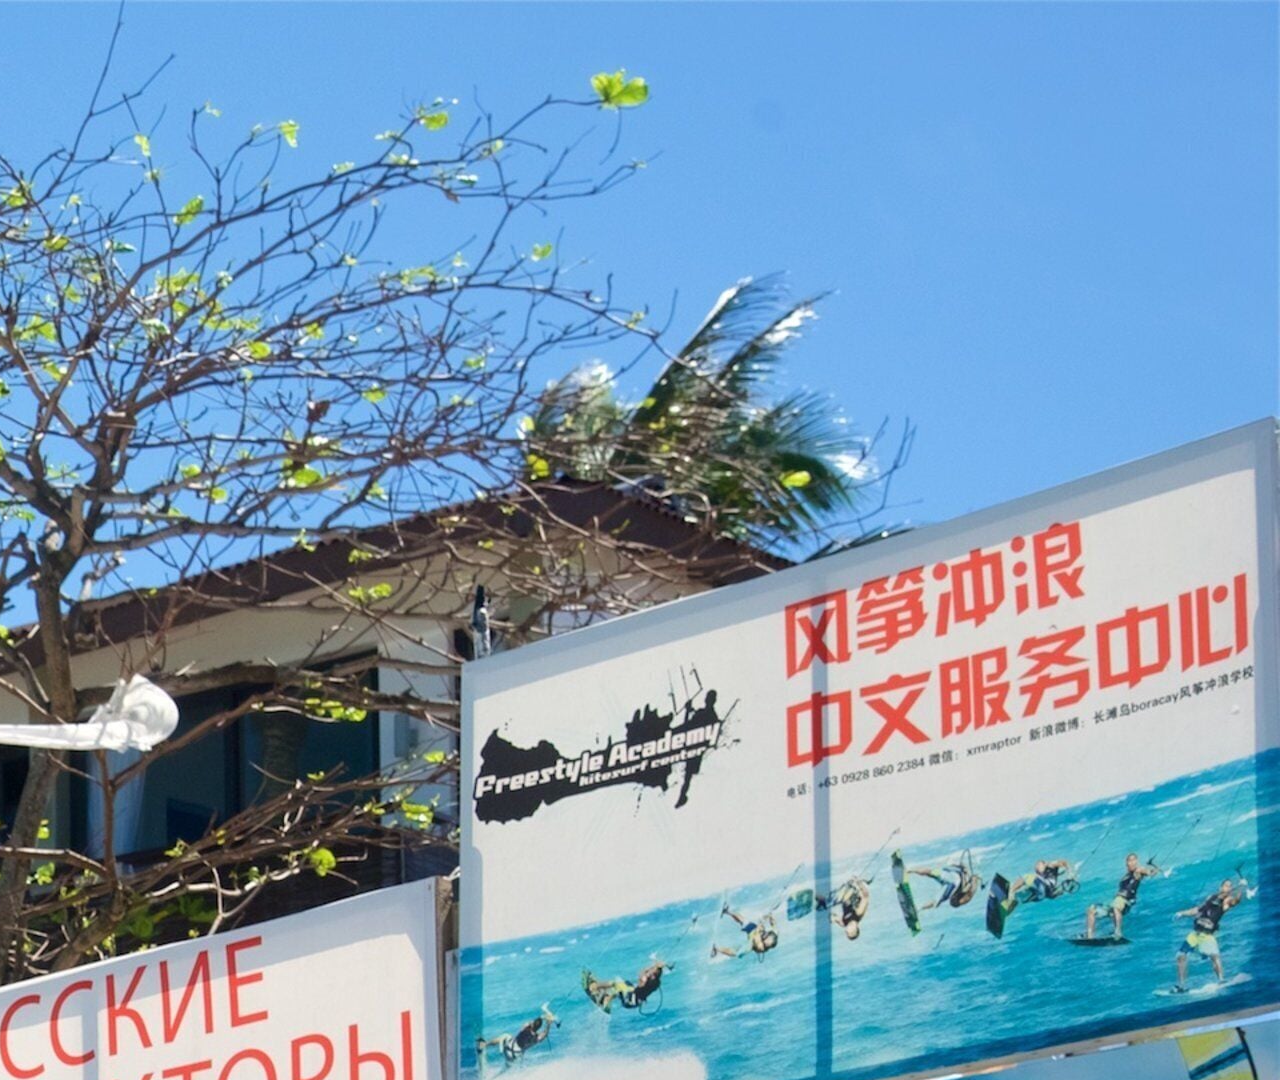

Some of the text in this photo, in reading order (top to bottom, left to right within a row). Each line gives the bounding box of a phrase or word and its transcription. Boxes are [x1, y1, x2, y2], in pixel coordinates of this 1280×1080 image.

[784, 521, 1085, 679] 风筝冲浪
[786, 573, 1248, 768] 中文服务中心
[475, 722, 721, 798] Freestyle Academy
[579, 747, 707, 787] kitesurf center
[842, 769, 870, 785] 0928
[873, 764, 894, 778] 860
[897, 757, 925, 773] 2384
